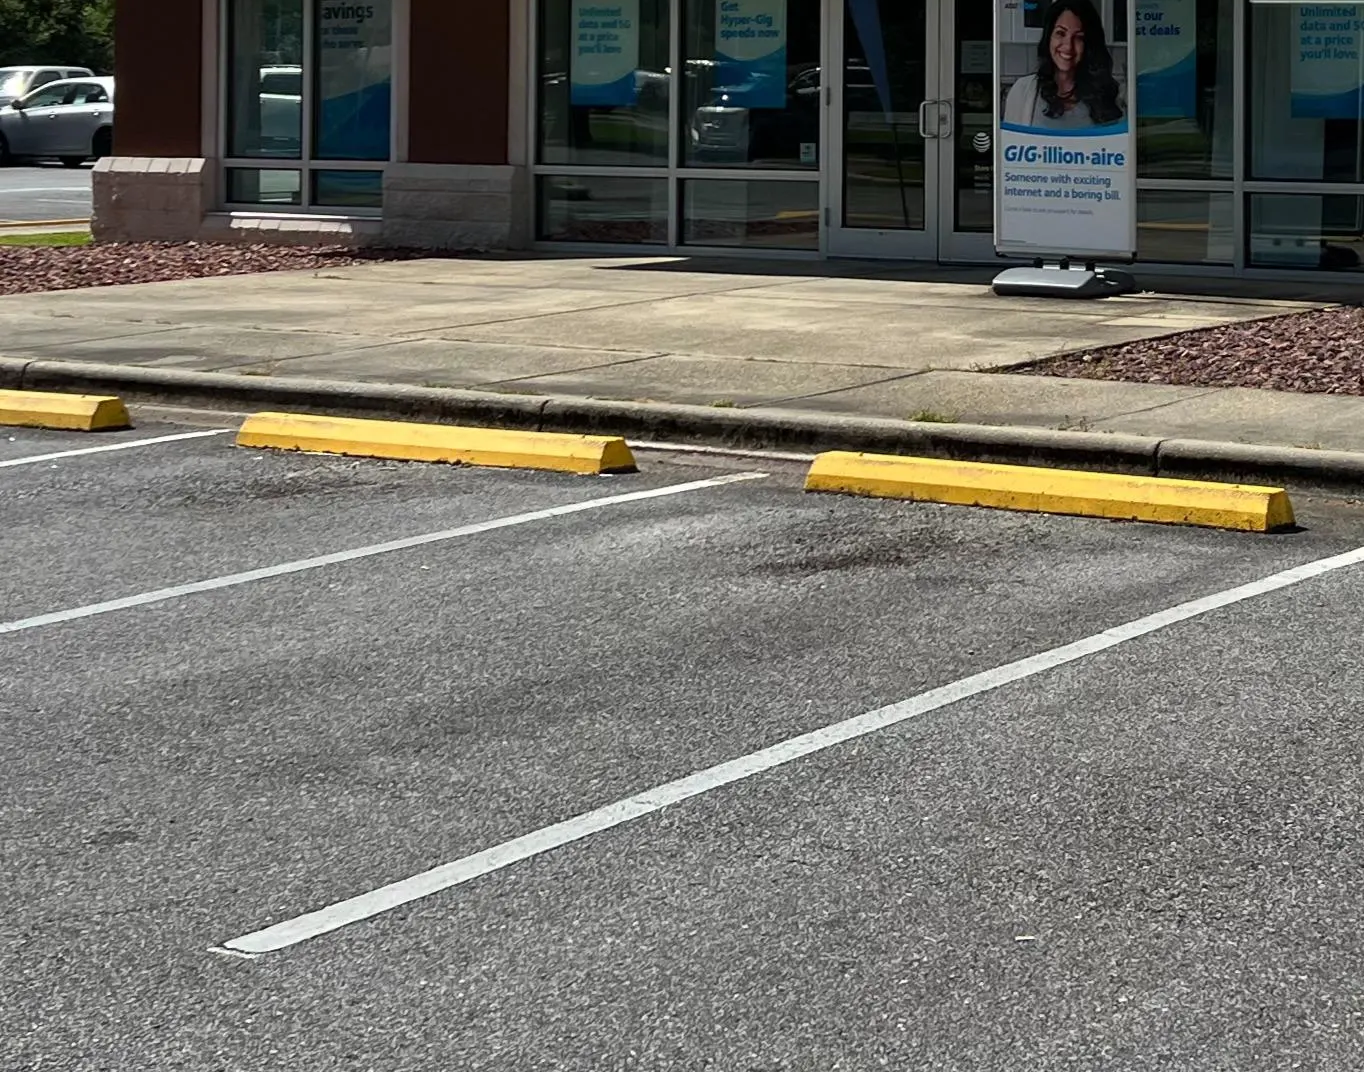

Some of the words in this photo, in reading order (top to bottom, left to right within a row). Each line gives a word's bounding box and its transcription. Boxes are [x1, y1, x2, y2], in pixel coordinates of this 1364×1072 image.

[321, 2, 374, 23] avings
[1144, 12, 1164, 21] our
[1300, 6, 1357, 17] Unlimited
[720, 14, 773, 27] Hyper-Gig
[1300, 20, 1327, 31] data
[1328, 20, 1351, 31] and
[720, 28, 755, 40] speeds
[757, 29, 780, 38] now
[1149, 24, 1180, 36] deals
[1300, 36, 1313, 45] at
[1314, 37, 1322, 45] a
[1324, 35, 1353, 47] price
[1300, 49, 1331, 61] you'll
[1004, 172, 1048, 183] Someone
[1050, 174, 1072, 184] with
[1073, 175, 1111, 188] exciting
[1044, 188, 1062, 198] and
[1071, 189, 1102, 202] boring
[1104, 190, 1121, 201] bill.
